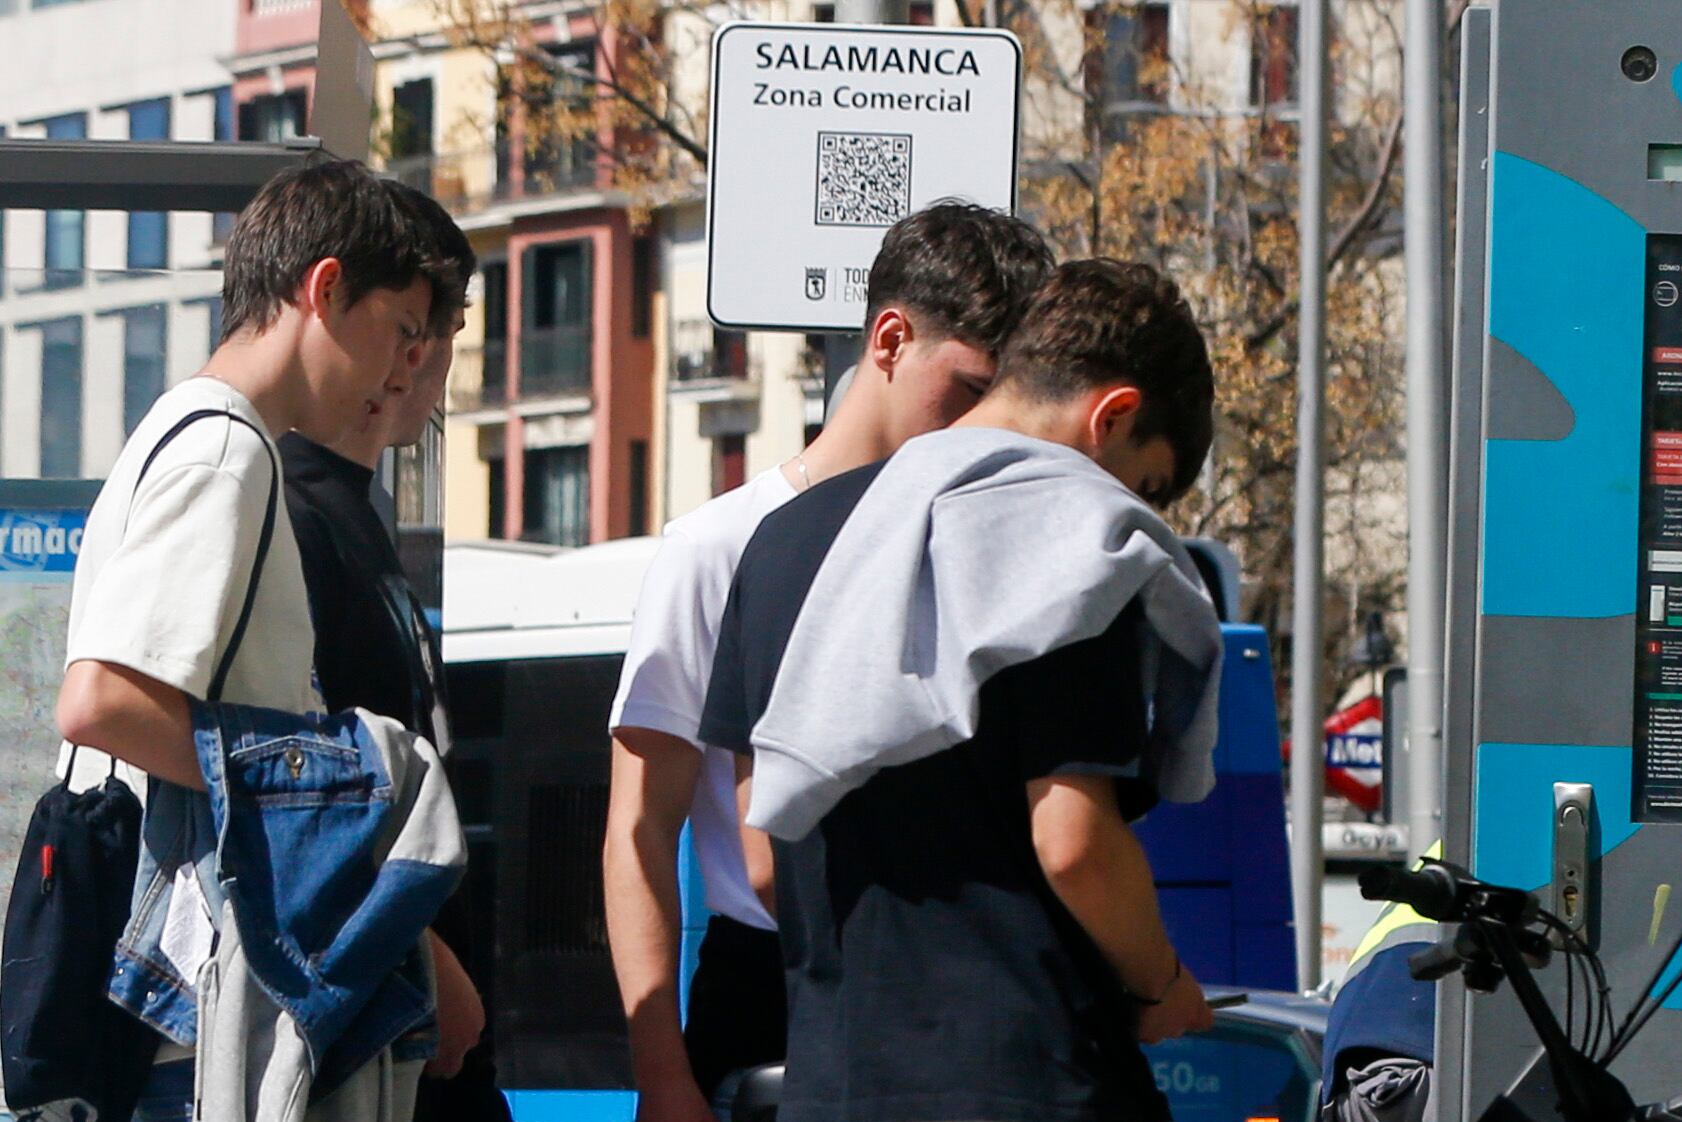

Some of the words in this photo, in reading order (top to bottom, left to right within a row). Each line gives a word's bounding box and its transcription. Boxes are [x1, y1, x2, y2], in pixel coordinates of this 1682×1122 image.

[755, 43, 980, 76] SALAMANCA
[753, 83, 822, 107] Zona
[833, 86, 971, 113] Comercial
